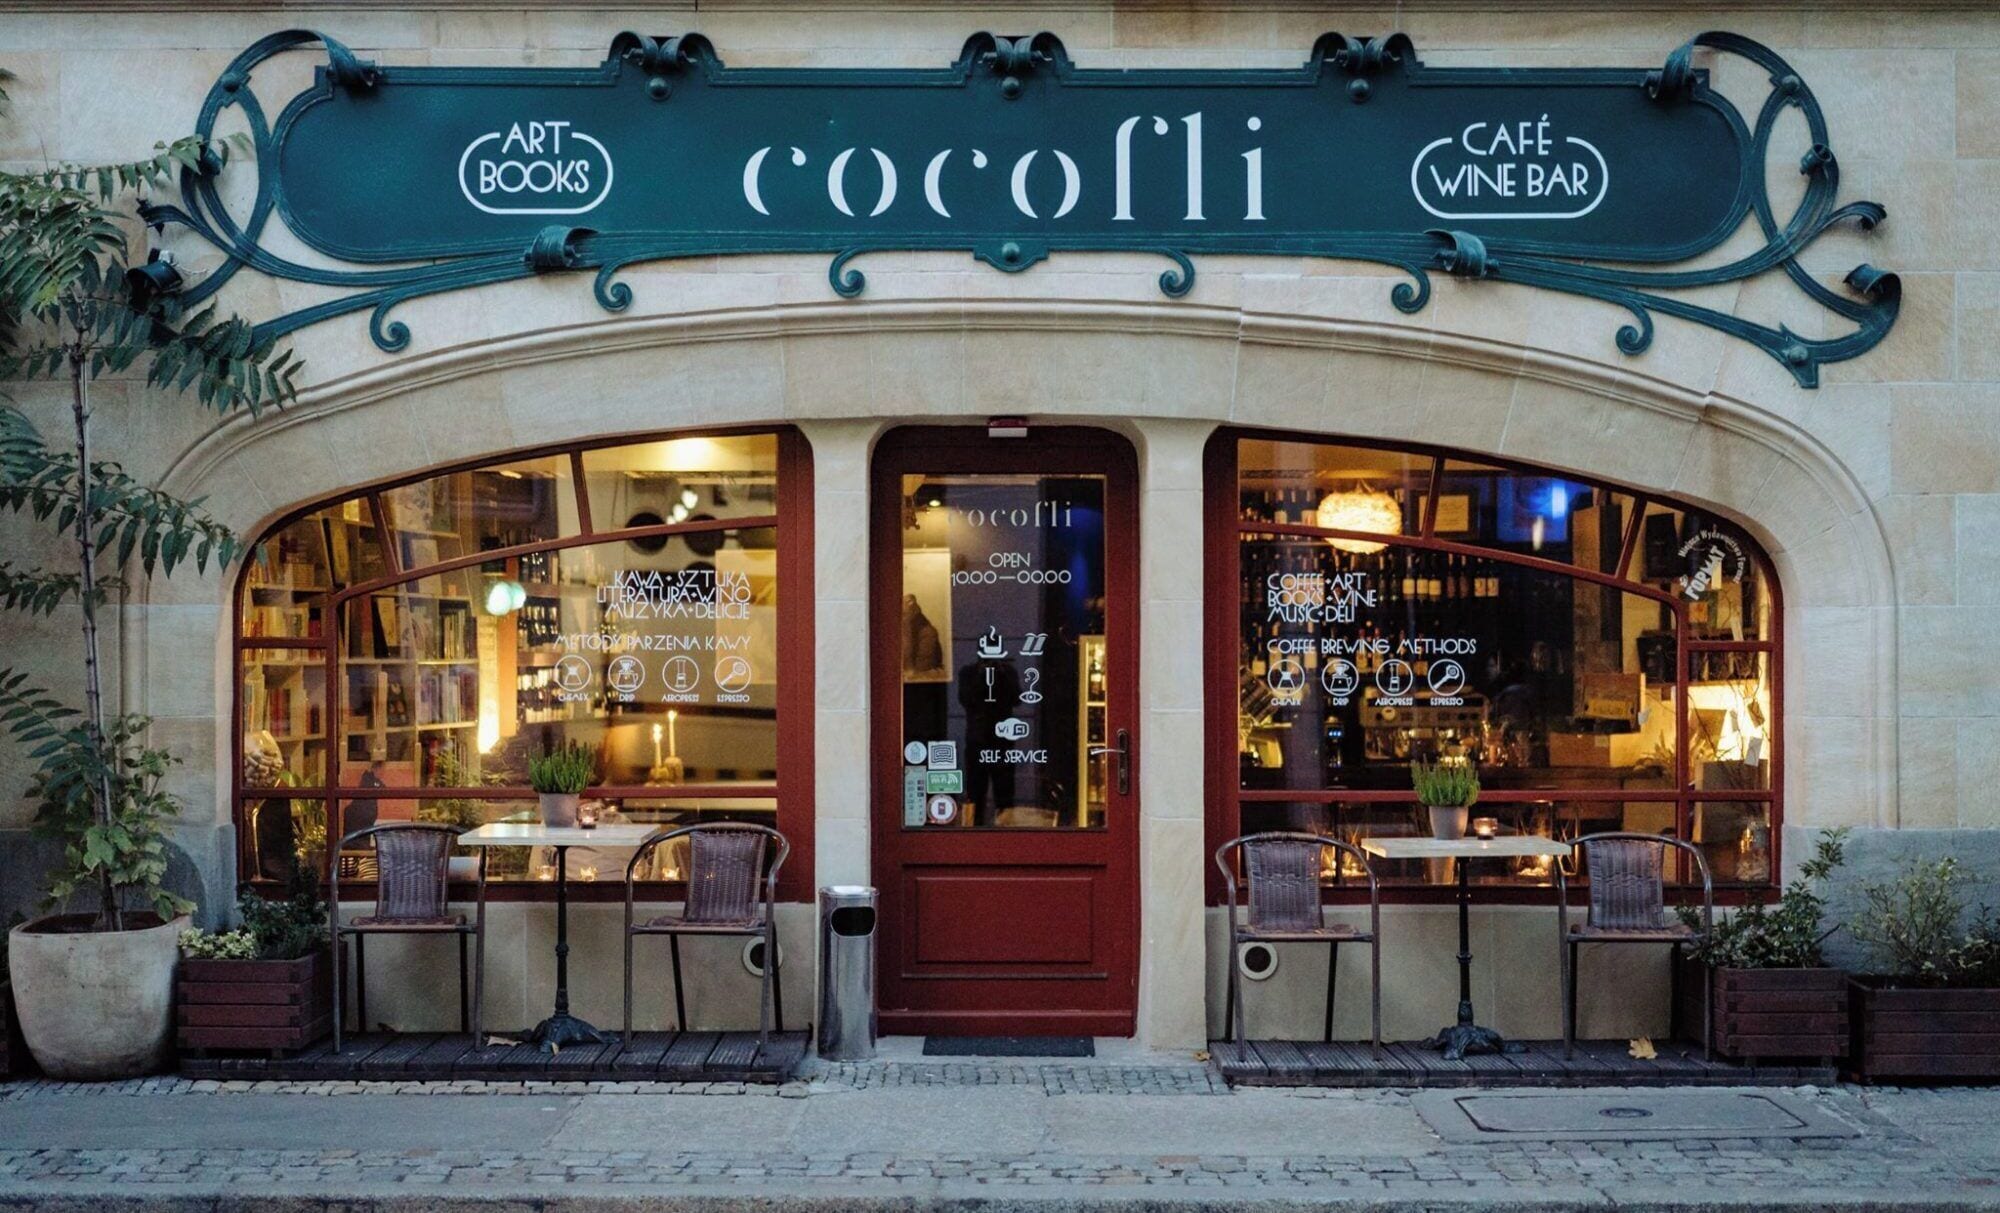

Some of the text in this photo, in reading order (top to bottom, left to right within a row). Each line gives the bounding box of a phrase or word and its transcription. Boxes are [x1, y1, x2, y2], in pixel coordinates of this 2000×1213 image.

[501, 121, 570, 154] ART
[1462, 113, 1552, 156] CAFÉ
[743, 112, 1266, 221] cocofli
[480, 160, 590, 193] BOOKS
[1430, 163, 1589, 197] WINE BAR
[989, 552, 1031, 568] OPEN
[614, 570, 750, 587] KAWA SZTUKA
[1267, 573, 1366, 590] COFFEE ART
[1685, 546, 1726, 600] FORMAT
[596, 586, 751, 603] LITERATURA WINO
[1268, 590, 1377, 607] BOOKS WINE
[604, 602, 750, 619] MUZYKA DELICJE
[1267, 606, 1354, 622] MUSIC DELI
[553, 635, 751, 650] METODY PARZENIA KAWY
[1267, 639, 1477, 654] COFFEE BREWING METHODS
[619, 693, 636, 702] DRIP
[717, 694, 750, 702] ESPRESSO
[1332, 697, 1349, 706] DRIP
[1375, 697, 1413, 706] AEROPRESS
[1430, 697, 1464, 706] ESPRESSO
[979, 749, 1047, 763] SELF SERVICE
